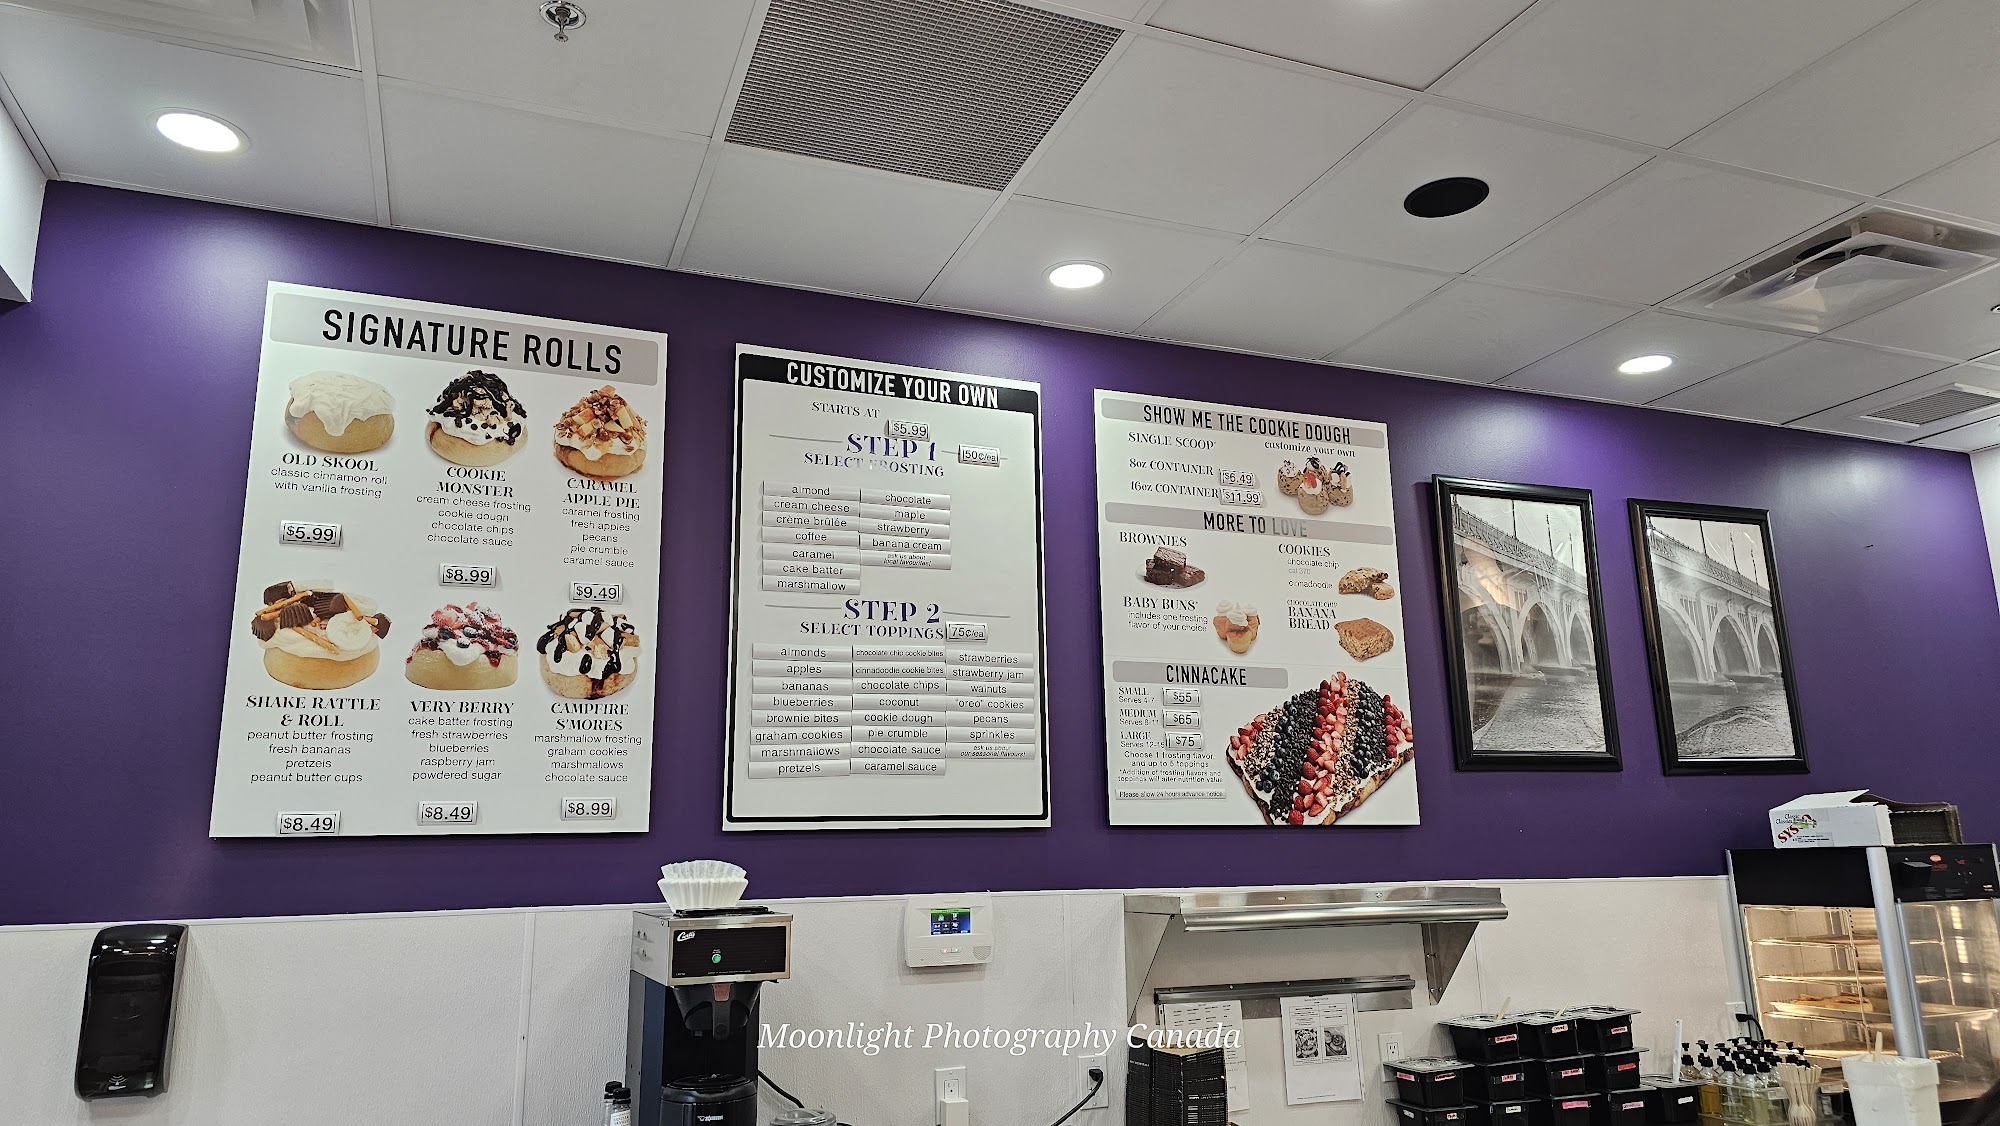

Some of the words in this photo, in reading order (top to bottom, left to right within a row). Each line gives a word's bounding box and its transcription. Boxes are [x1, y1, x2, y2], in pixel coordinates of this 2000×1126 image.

[323, 309, 510, 362] SIGNATURE
[523, 333, 623, 375] ROLLS
[787, 362, 895, 396] CUSTOMIZE
[902, 376, 951, 403] YOUR
[958, 384, 998, 409] OWN
[811, 402, 860, 416] STARTS
[864, 408, 880, 419] AT
[893, 422, 928, 437] $5.99
[1143, 405, 1185, 426] SHOW
[1192, 411, 1212, 428] ME
[1218, 414, 1243, 432] THE
[1249, 417, 1300, 439] COOKIE
[1305, 424, 1351, 444] DOUGH
[1128, 432, 1172, 446] SINGLE
[847, 434, 918, 459] STEP
[928, 442, 936, 461] 1
[1265, 441, 1311, 452] customize
[1314, 446, 1334, 457] your
[1337, 449, 1356, 457] own
[282, 453, 316, 466] OLD
[322, 455, 378, 472] SKOOL
[804, 453, 863, 469] SELECT
[869, 459, 944, 477] FROSTING
[1129, 458, 1147, 469] 8oz
[1149, 460, 1214, 476] CONTAINER
[271, 468, 310, 478] classic
[313, 470, 368, 484] cinnamon
[371, 475, 388, 484] roll
[447, 466, 506, 482] COOKIE
[1225, 472, 1252, 484] $6.49
[275, 481, 298, 490] with
[302, 483, 338, 494] vanilla
[340, 486, 382, 498] frosting
[436, 481, 513, 498] MONSTER
[567, 478, 637, 494] CARAMEL
[792, 486, 830, 496] almond
[1130, 481, 1153, 492] 16oz
[1155, 482, 1219, 498] CONTAINER
[416, 495, 450, 505] cream
[453, 497, 490, 508] cheese
[493, 500, 531, 512] frosting
[563, 493, 610, 507] APPLE
[615, 498, 640, 509] PIE
[885, 493, 932, 505] chocolate
[1225, 491, 1259, 503] $11.99
[774, 500, 808, 510] cream
[812, 502, 850, 513] cheese
[438, 508, 472, 519] cookie
[476, 512, 509, 523] dough
[562, 507, 601, 518] caramel
[604, 510, 640, 522] frosting
[432, 520, 483, 532] chocolate
[487, 524, 514, 534] chips
[571, 519, 594, 529] fresh
[598, 522, 630, 532] apples
[878, 523, 930, 536] strawberry
[1203, 512, 1244, 532] MORE
[1249, 516, 1266, 533] TO
[1272, 518, 1308, 537] LOVE
[286, 526, 334, 541] $5.99
[582, 534, 618, 542] pecans
[796, 532, 826, 541] coffee
[1120, 532, 1187, 547] BROWNIES
[427, 534, 479, 545] chocolate
[483, 539, 513, 547] sauce
[872, 538, 910, 549] banana
[912, 541, 942, 550] cream
[571, 544, 586, 554] pie
[588, 545, 628, 555] crumble
[792, 550, 835, 560] caramel
[1278, 543, 1330, 557] COOKIES
[564, 556, 603, 566] caramel
[606, 559, 634, 568] sauce
[446, 568, 490, 583] $8.99
[783, 564, 809, 574] cake
[812, 564, 843, 575] batter
[778, 580, 846, 591] marshmallow
[576, 585, 616, 600] $9.49
[1123, 596, 1158, 609] BABY
[844, 598, 916, 622] STEP
[927, 603, 940, 623] 2
[1288, 607, 1336, 619] BANANA
[1289, 618, 1330, 629] BREAD
[800, 622, 860, 636] SELECT
[866, 625, 944, 639] TOPPINGS
[959, 653, 1018, 664] strawberries
[786, 664, 822, 675] apples
[1166, 665, 1247, 685] CINNACAKE
[782, 681, 829, 691] bananas
[861, 679, 909, 690] chocolate
[911, 680, 940, 690] chips
[1118, 687, 1149, 696] SMALL
[246, 695, 305, 709] SHAKE
[312, 697, 381, 711] RATTLE
[410, 700, 455, 713] VERY
[460, 701, 514, 714] BERRY
[774, 697, 834, 707] blueberries
[880, 698, 919, 707] coconut
[551, 702, 629, 716] CAMPFIRE
[1119, 709, 1156, 717] MEDIUM
[281, 714, 293, 726] &
[299, 714, 344, 727] ROLL
[408, 717, 434, 726] cake
[438, 717, 469, 726] batter
[473, 717, 512, 729] frosting
[767, 714, 809, 723] brownie
[814, 714, 839, 723] bites
[864, 712, 898, 722] cookie
[902, 714, 933, 724] dough
[1174, 714, 1192, 724] $65
[556, 719, 622, 731] S'MORES
[248, 730, 288, 741] peanut
[293, 730, 326, 740] butter
[331, 731, 373, 742] frosting
[412, 730, 438, 739] fresh
[442, 730, 508, 740] strawberries
[534, 734, 601, 743] marshmallow
[605, 734, 642, 745] frosting
[1120, 732, 1152, 740] LARGE
[1176, 736, 1195, 746] $75
[269, 744, 297, 754] fresh
[302, 745, 351, 754] bananas
[429, 743, 489, 753] blueberries
[548, 747, 586, 757] graham
[589, 747, 628, 756] cookies
[286, 759, 332, 770] pretzels
[421, 757, 472, 768] raspberry
[476, 757, 495, 767] jam
[551, 760, 624, 769] marshmallows
[251, 773, 292, 783] peanut
[296, 773, 330, 782] butter
[335, 774, 363, 784] cups
[413, 770, 467, 781] powdered
[472, 772, 501, 781] sugar
[545, 773, 595, 782] chocolate
[598, 774, 628, 782] sauce
[425, 806, 471, 820] $8.49
[568, 802, 610, 816] $8.99
[284, 817, 333, 831] $8.49
